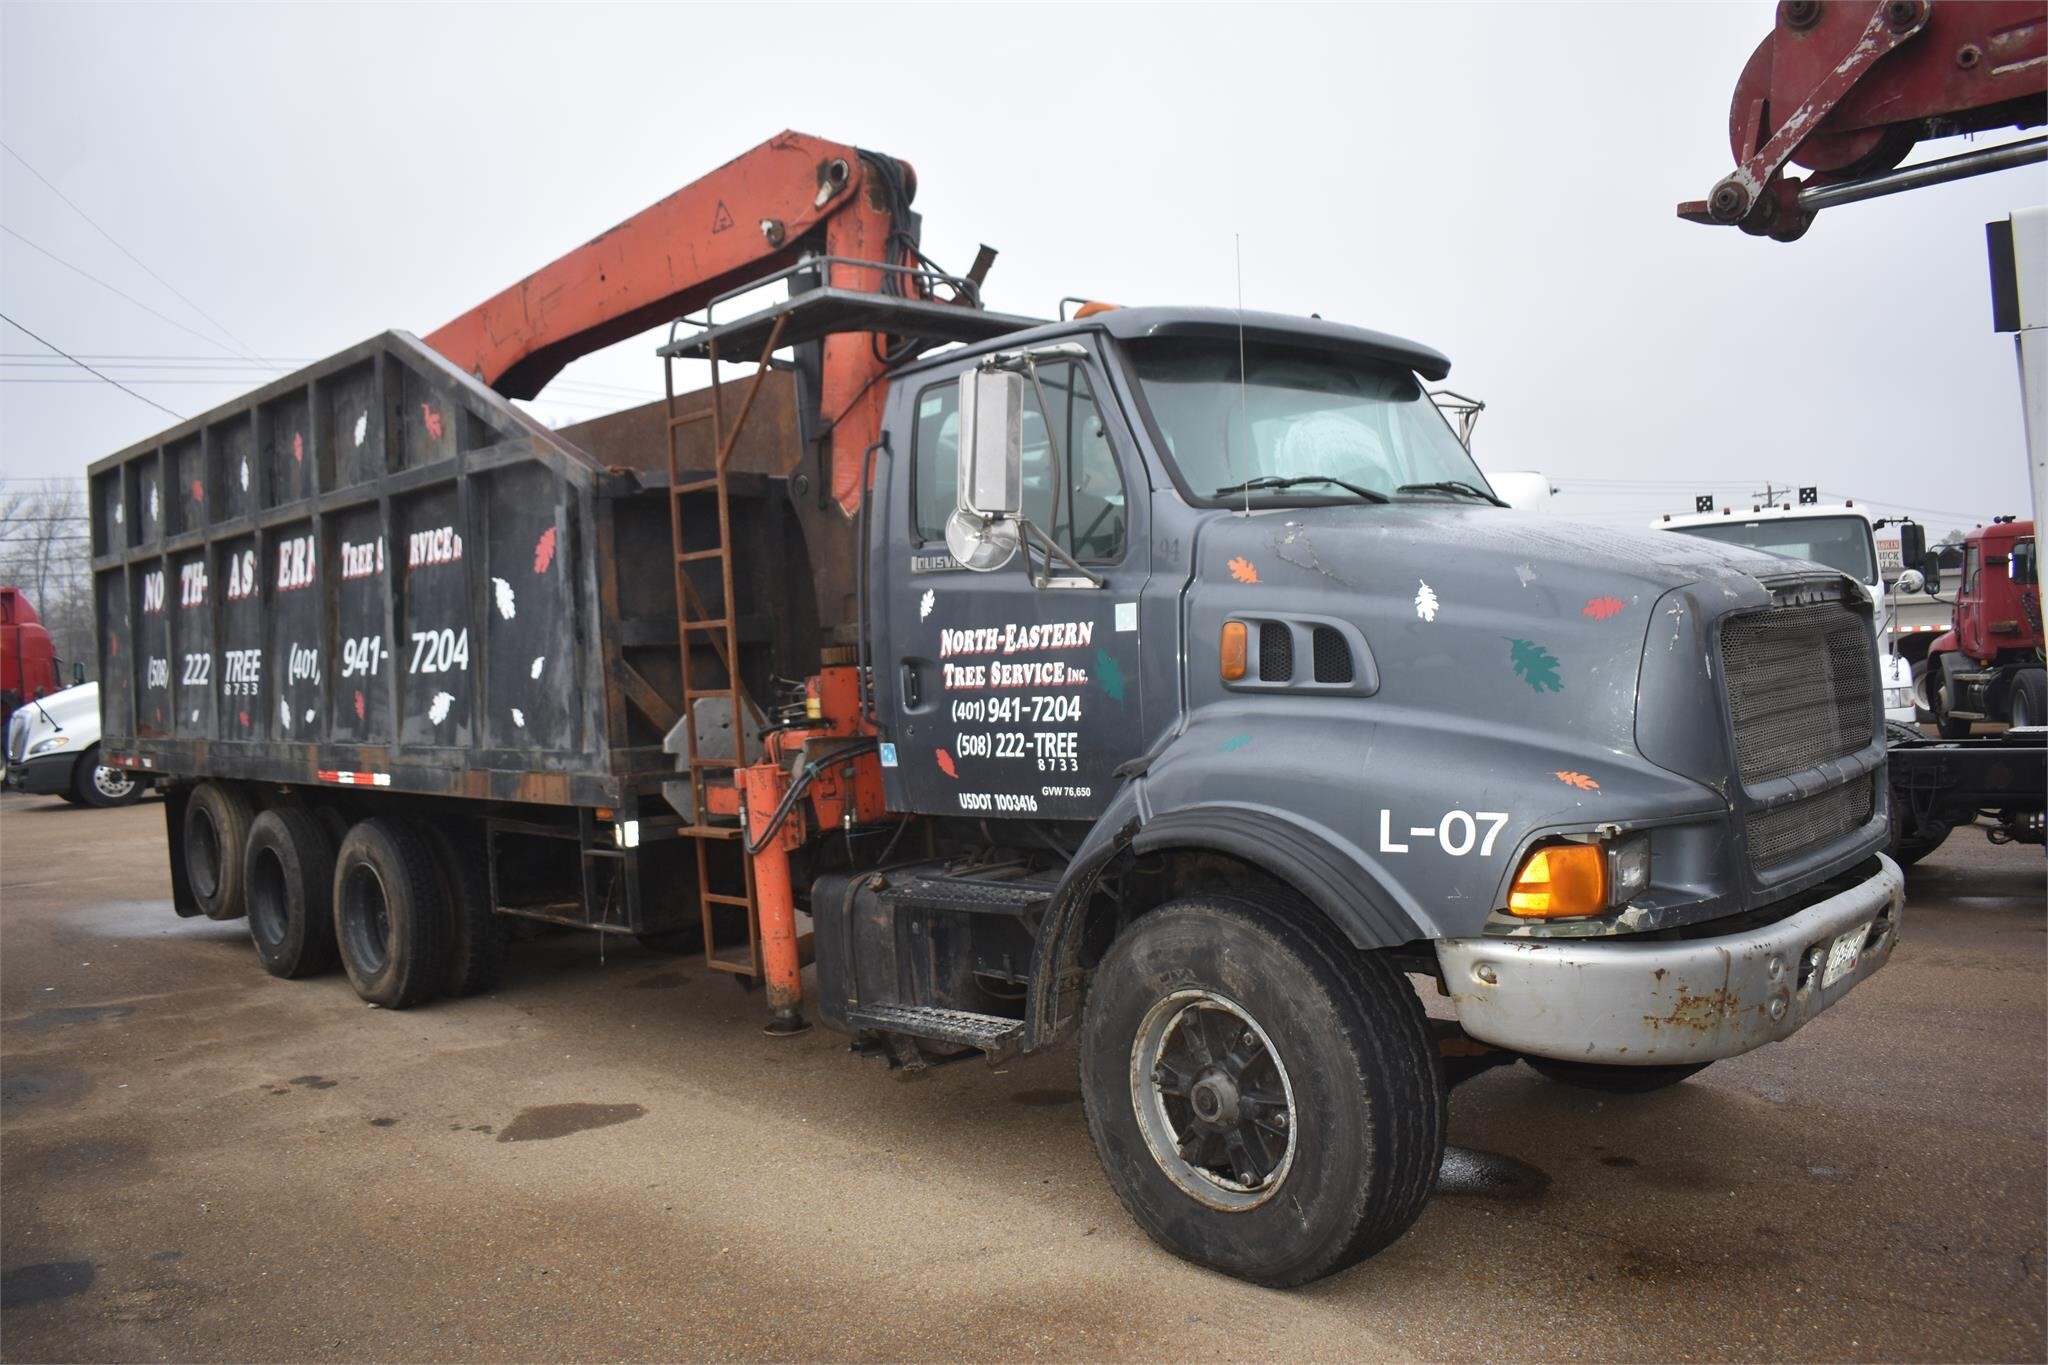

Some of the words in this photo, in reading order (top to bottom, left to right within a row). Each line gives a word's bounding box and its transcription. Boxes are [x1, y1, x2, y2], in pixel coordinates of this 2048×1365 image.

[911, 556, 964, 573] LOUISVI
[939, 621, 1095, 659] NORTH-EASTERN
[225, 650, 262, 682] TREE
[408, 627, 469, 675] 7204
[943, 662, 986, 690] TREE
[990, 660, 1065, 687] SERVICE
[952, 698, 986, 723] (401)
[988, 695, 1082, 723] 941-7204
[956, 732, 992, 758] (508)
[995, 732, 1078, 758] 222-TREE
[958, 793, 993, 810] USDOT
[994, 793, 1038, 812] 1003416
[1041, 786, 1063, 797] GVW
[1064, 786, 1091, 798] 76,650
[1380, 809, 1509, 856] L-07
